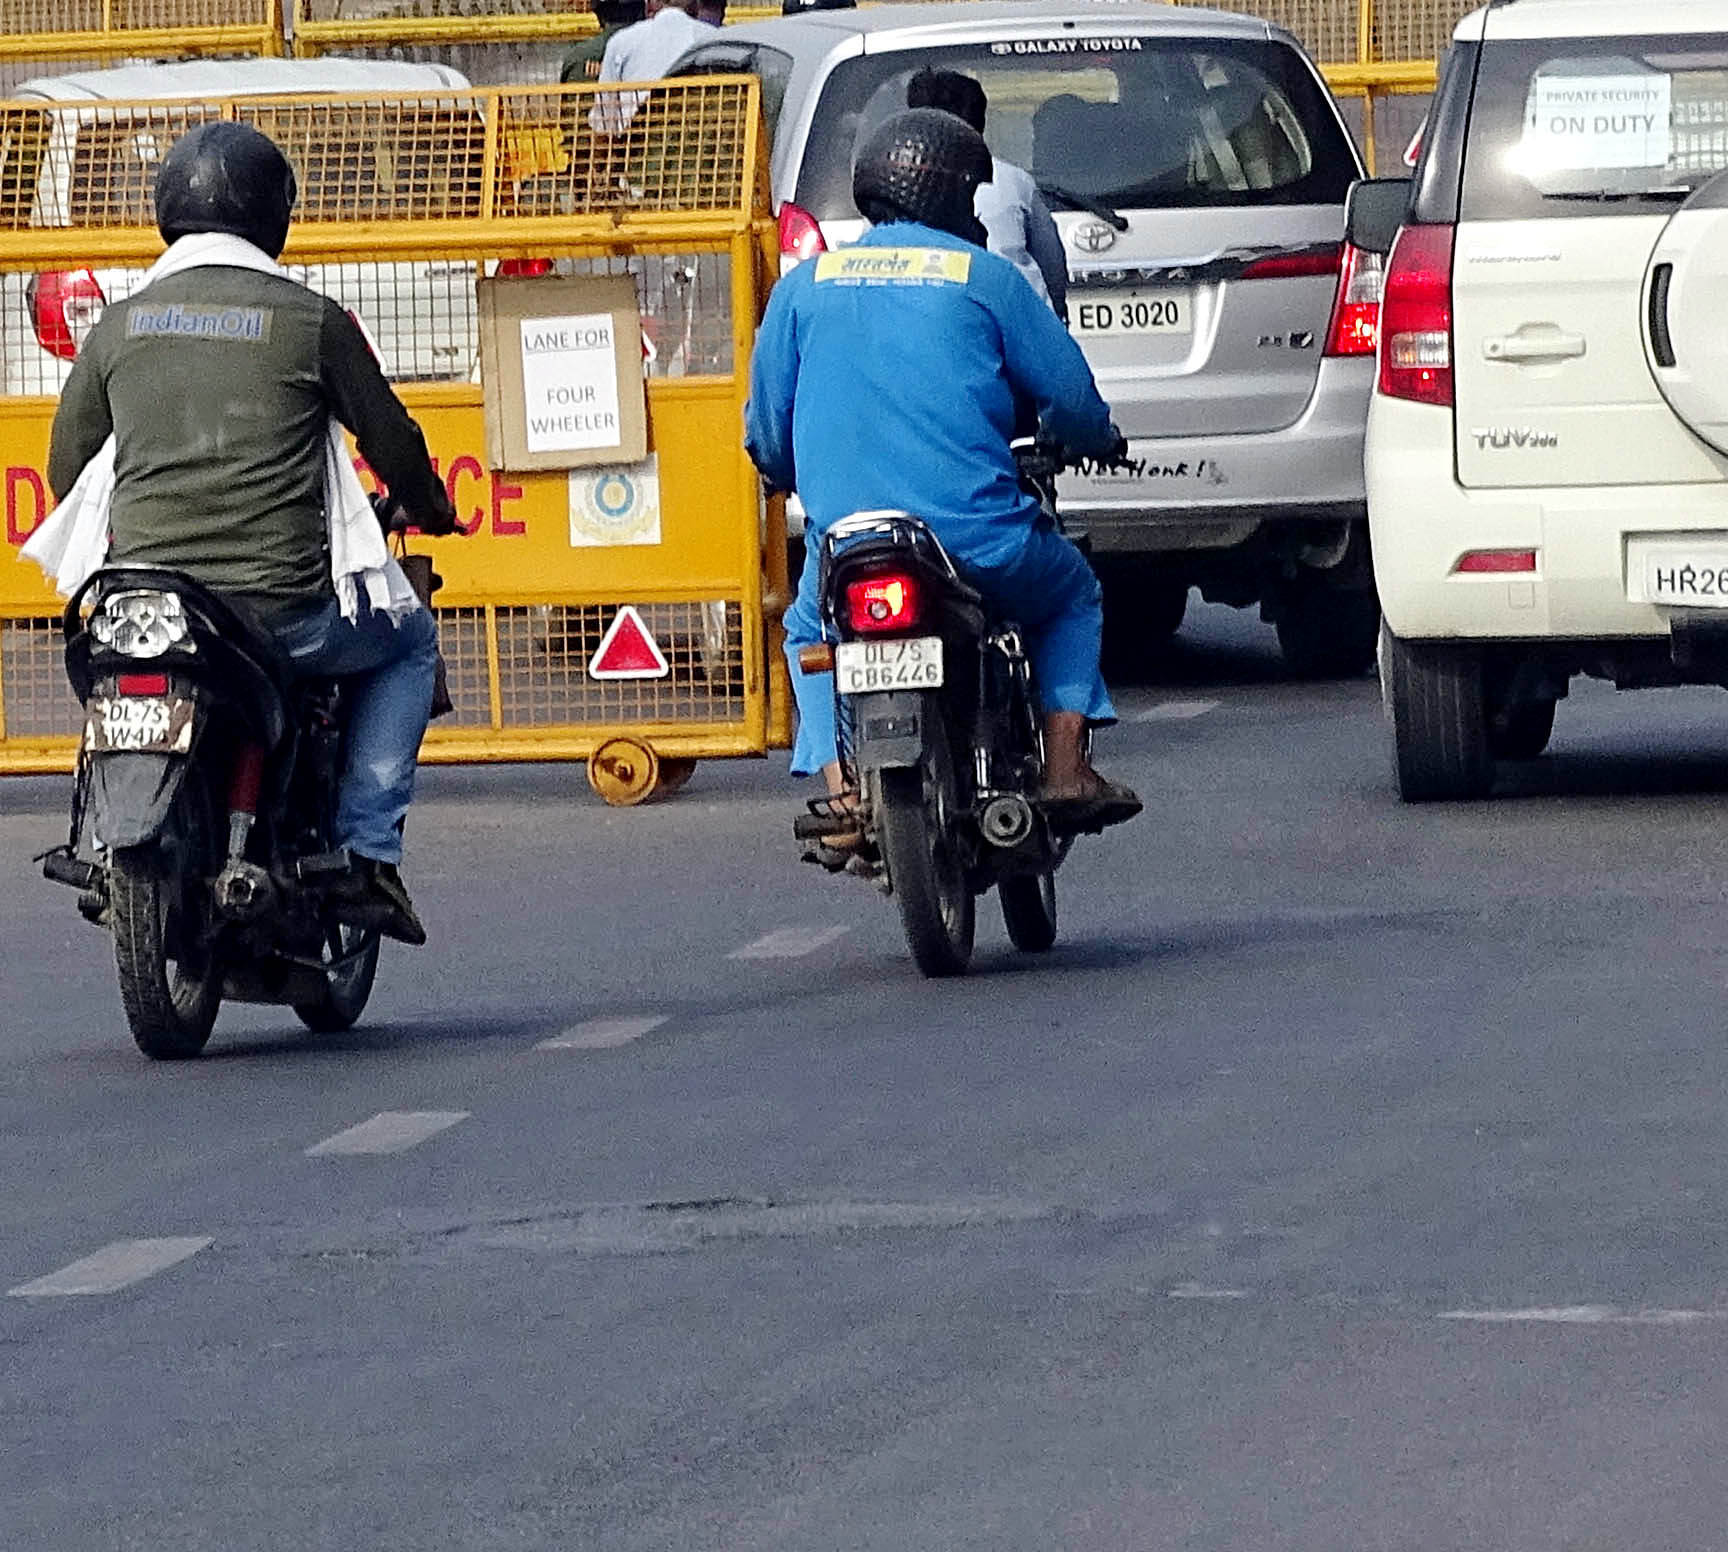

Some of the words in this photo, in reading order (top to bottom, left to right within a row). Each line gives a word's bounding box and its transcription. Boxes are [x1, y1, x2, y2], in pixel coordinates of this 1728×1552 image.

[1014, 39, 1078, 55] GALAXY
[1081, 37, 1143, 52] TOYOTA
[1546, 90, 1597, 103] PRIVATE
[1601, 89, 1660, 102] SECURITY
[1550, 115, 1585, 135] ON
[1593, 113, 1656, 135] DUTY
[131, 307, 262, 337] IndianOil
[1079, 303, 1113, 330] ED
[1121, 300, 1180, 329] 3020
[524, 330, 569, 352] LANE
[575, 328, 611, 347] FOR
[547, 384, 597, 405] FOUR
[530, 411, 616, 435] WHEELER
